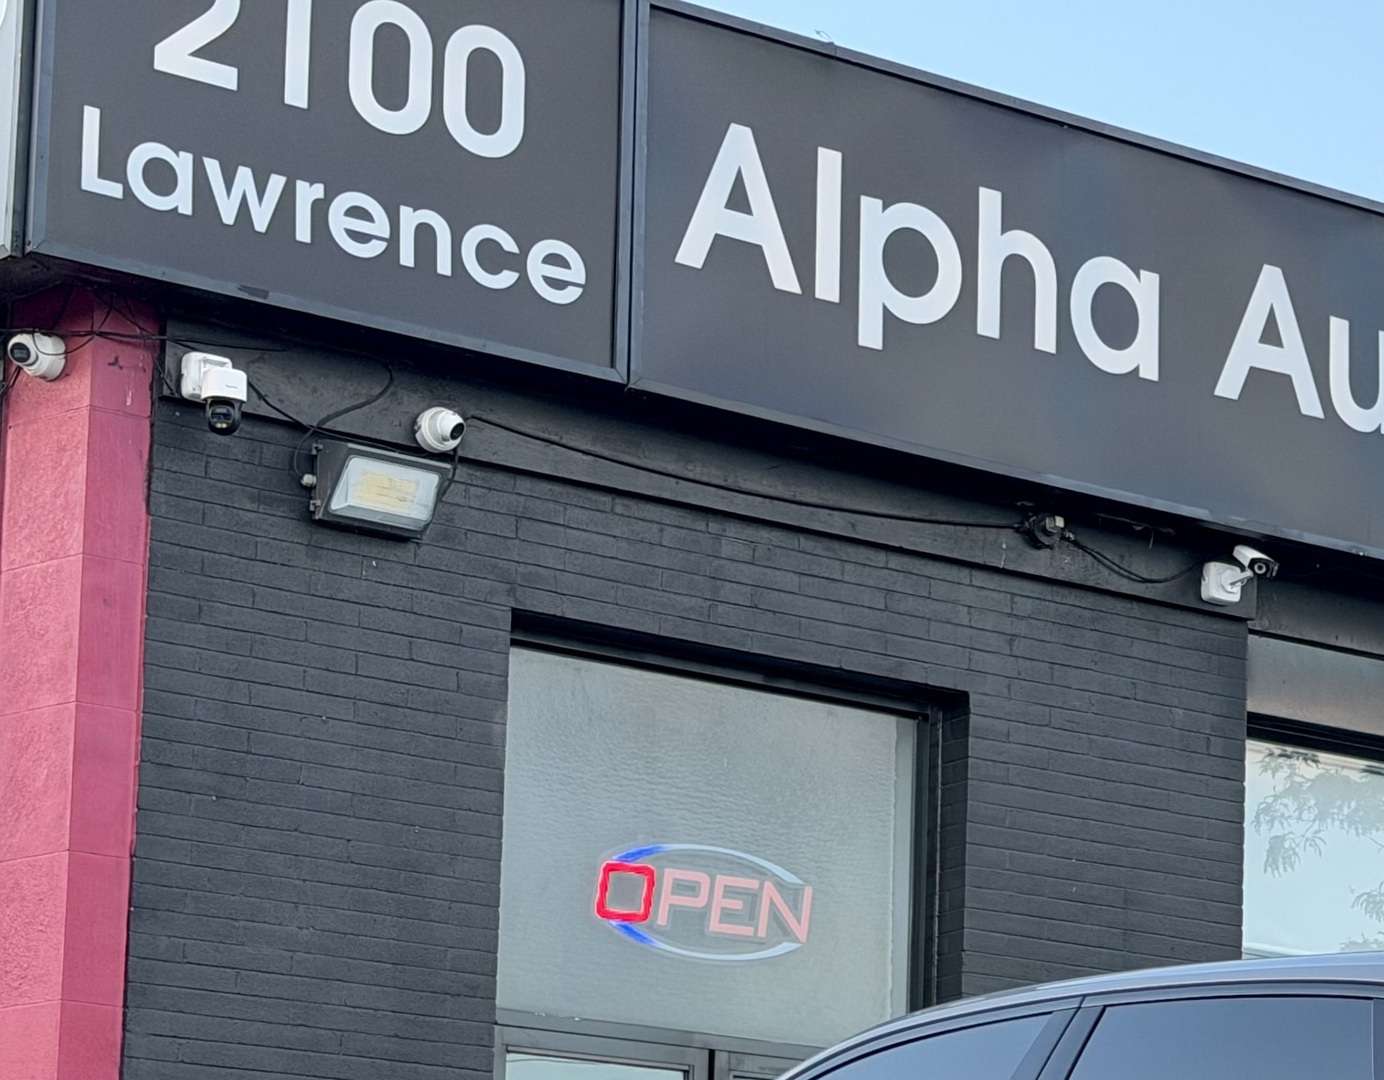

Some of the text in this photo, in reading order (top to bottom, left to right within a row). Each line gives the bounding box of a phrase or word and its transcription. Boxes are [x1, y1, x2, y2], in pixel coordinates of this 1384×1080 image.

[154, 0, 525, 158] 2100
[81, 105, 586, 304] Lawrence
[674, 122, 1160, 382] Alpha
[595, 860, 813, 944] OPEN
